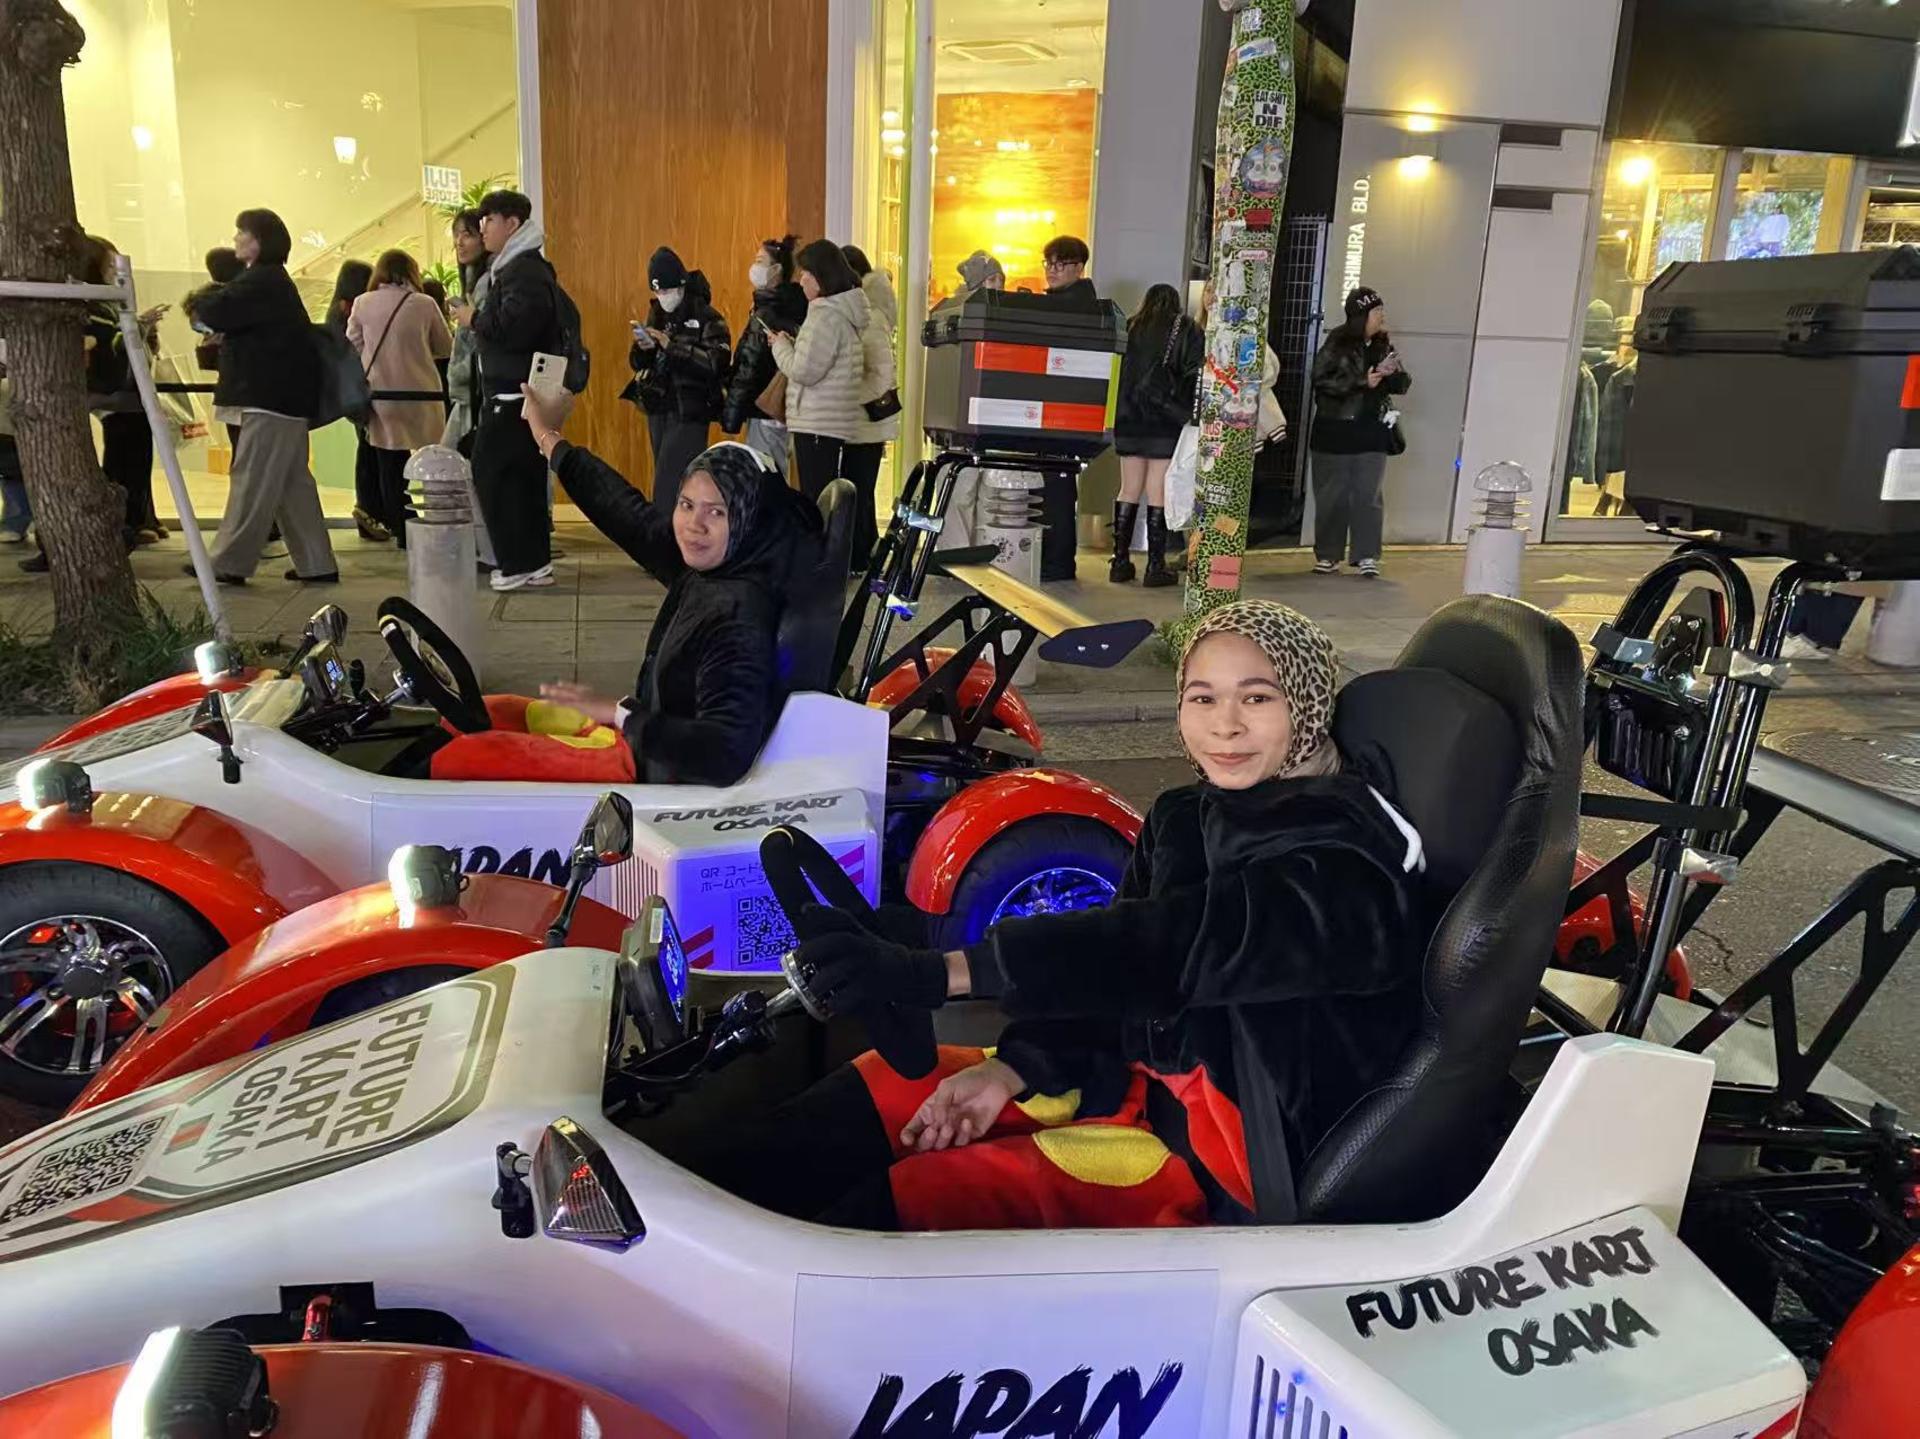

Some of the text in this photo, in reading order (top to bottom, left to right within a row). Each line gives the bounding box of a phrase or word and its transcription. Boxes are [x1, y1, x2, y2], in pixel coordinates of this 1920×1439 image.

[1342, 174, 1371, 306] SHIMURA BLD.
[654, 796, 842, 823] FUTURE KART
[713, 813, 808, 831] OSAKA
[701, 867, 720, 878] QR
[194, 1066, 287, 1173] OSAKA
[255, 1039, 362, 1150] KART
[324, 1002, 434, 1149] FUTURE
[1346, 1226, 1660, 1339] FUTURE KART
[1487, 1297, 1661, 1376] OSAKA
[851, 1360, 1184, 1439] JAPAN
